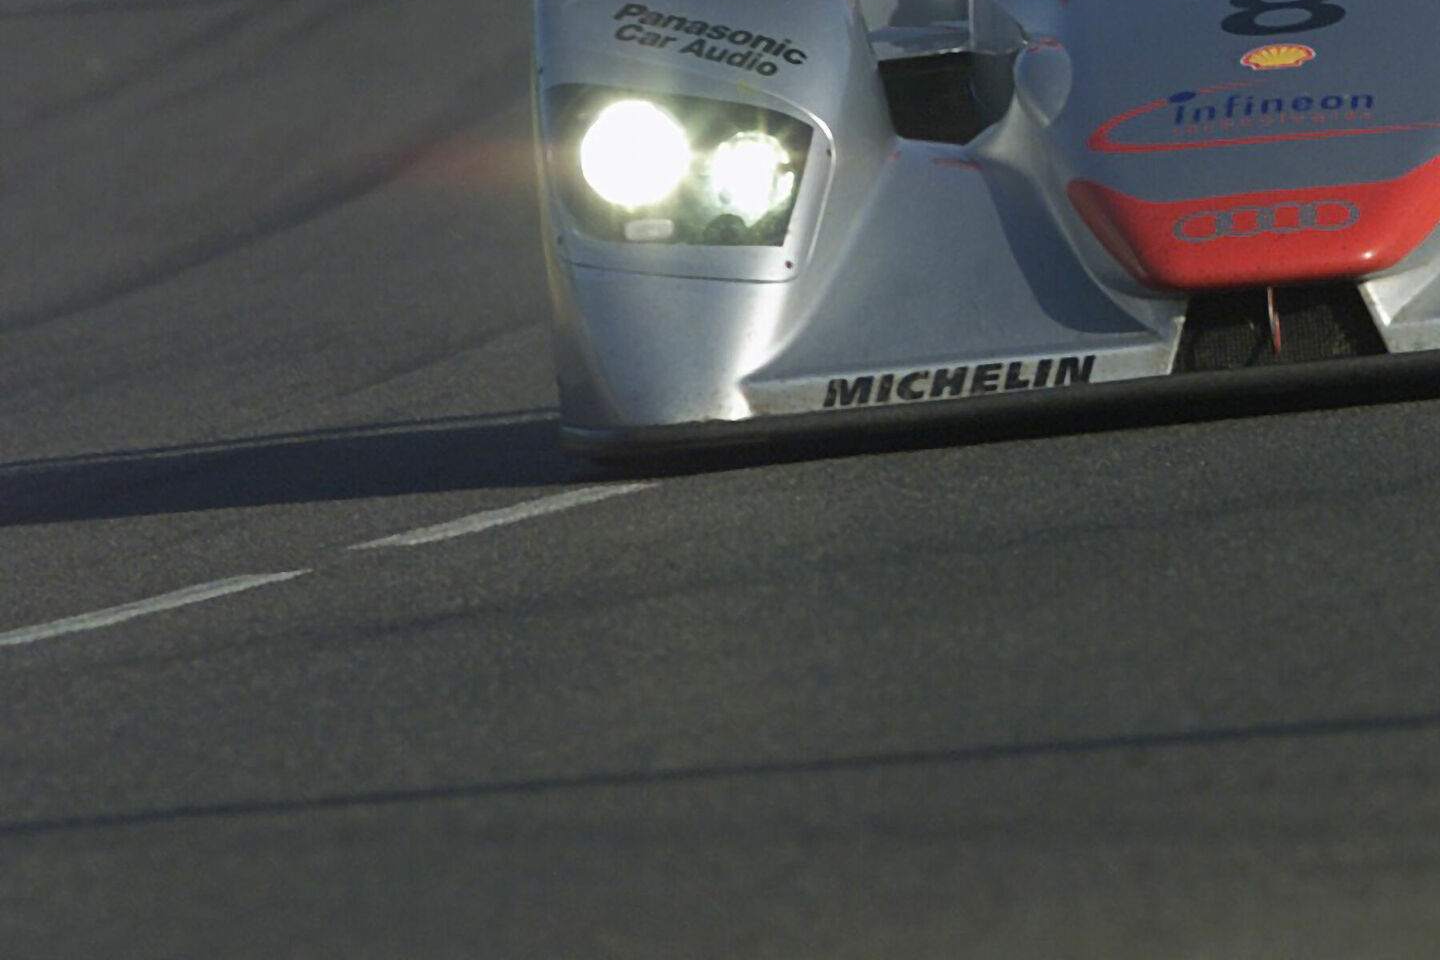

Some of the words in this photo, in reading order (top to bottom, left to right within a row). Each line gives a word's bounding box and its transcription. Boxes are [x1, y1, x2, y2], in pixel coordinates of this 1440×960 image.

[613, 2, 808, 65] Panasonic
[614, 23, 677, 49] Car
[679, 39, 778, 77] Audio
[823, 355, 1096, 408] MICHELIN
